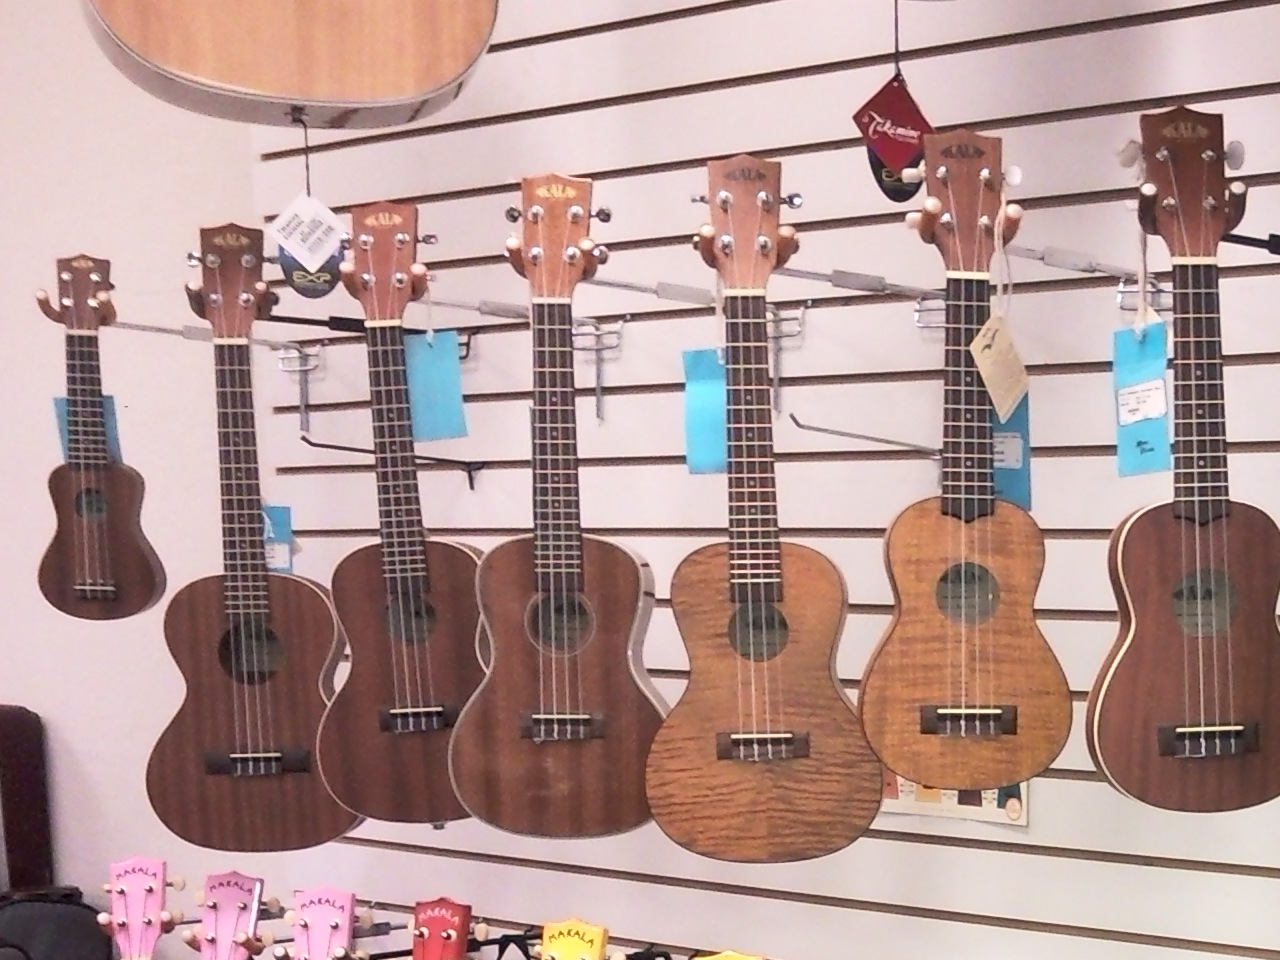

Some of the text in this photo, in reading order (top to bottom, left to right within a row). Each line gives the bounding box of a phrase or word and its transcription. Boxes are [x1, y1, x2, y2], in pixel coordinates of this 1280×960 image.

[115, 866, 158, 881] MAKALA
[209, 879, 253, 896] MAKALA
[300, 897, 345, 913] MAKALA
[417, 906, 460, 927] MAKALA
[548, 928, 596, 949] MAKALA
